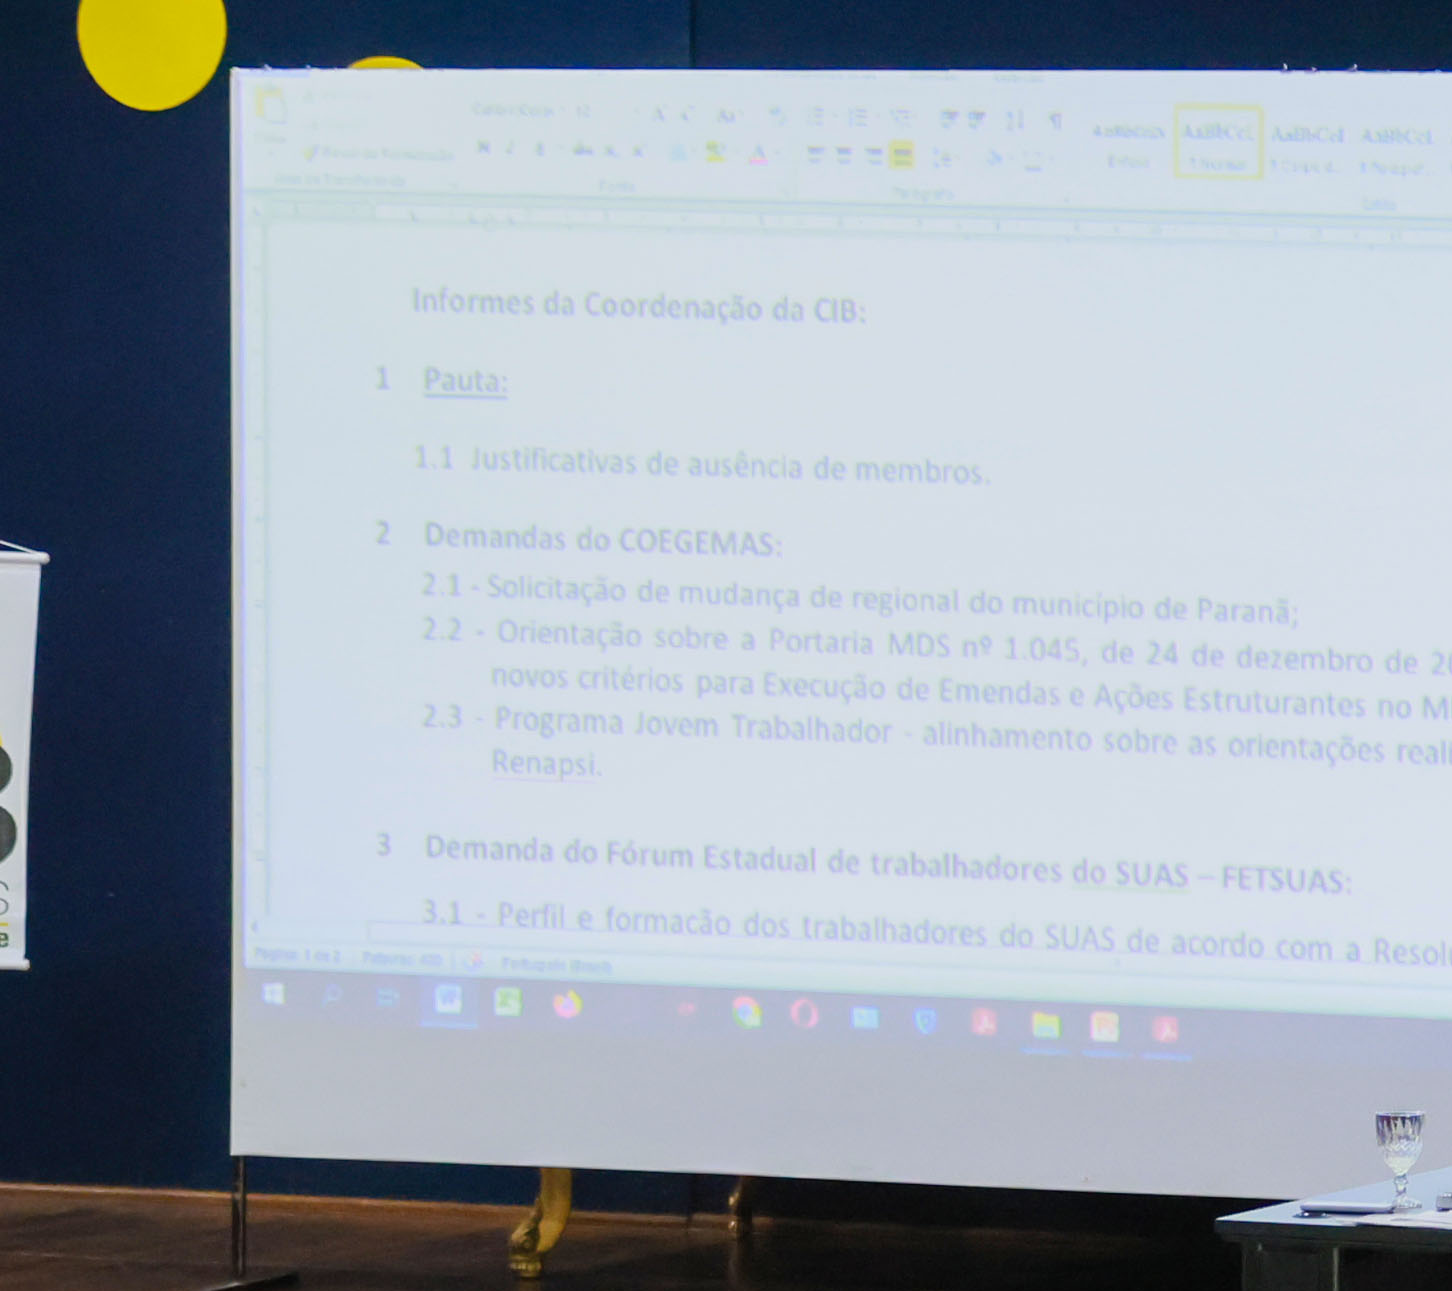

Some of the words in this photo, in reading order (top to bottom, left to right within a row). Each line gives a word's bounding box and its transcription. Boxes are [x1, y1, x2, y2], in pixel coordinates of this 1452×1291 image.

[412, 285, 536, 317] Informes
[543, 289, 576, 317] da
[584, 291, 764, 324] Coordenação
[771, 296, 806, 324] da
[813, 298, 866, 325] CIB:
[376, 365, 391, 391] 1
[424, 367, 509, 397] Pauta:
[416, 445, 454, 470] 1.1
[472, 446, 639, 477] Justificativas
[646, 450, 680, 478] de
[689, 451, 804, 481] ausência
[813, 454, 848, 483] de
[855, 458, 991, 486] membros.
[375, 519, 392, 546] 2
[424, 521, 567, 552] Demandas
[576, 526, 612, 553] do
[618, 526, 783, 559] COEGEMAS:
[422, 571, 463, 598] 2.1
[487, 573, 628, 608] Solicitação
[637, 578, 671, 605] de
[679, 581, 801, 615] mudança
[809, 584, 844, 610] de
[852, 587, 960, 619] regional
[968, 590, 1005, 616] do
[1012, 591, 1145, 626] município
[1154, 596, 1189, 623] de
[1198, 596, 1299, 631] Paranã;
[422, 615, 463, 643] 2.2
[498, 618, 643, 654] Orientação
[655, 625, 730, 651] sobre
[741, 631, 757, 652] a
[770, 626, 874, 656] Portaria
[889, 631, 952, 659] MDS
[1101, 639, 1135, 666] de
[1147, 639, 1179, 667] 24
[1191, 642, 1226, 669] de
[1236, 644, 1375, 675] dezembro
[1384, 649, 1419, 676] de
[492, 667, 569, 690] novos
[578, 665, 684, 694] critérios
[697, 674, 755, 700] para
[763, 671, 887, 706] Execução
[897, 676, 931, 703] de
[939, 676, 1061, 708] Emendas
[1069, 687, 1085, 709] e
[1093, 682, 1174, 716] Ações
[1184, 685, 1368, 719] Estruturantes
[1378, 698, 1413, 721] no
[422, 703, 464, 730] 2.3
[496, 705, 625, 740] Programa
[635, 711, 720, 738] Jovem
[731, 713, 895, 745] Trabalhador
[922, 720, 1094, 753] alinhamento
[1103, 727, 1179, 756] sobre
[1187, 735, 1219, 758] as
[1228, 733, 1387, 770] orientações
[492, 750, 603, 781] Renapsi.
[376, 831, 392, 858] 3
[426, 833, 556, 864] Demanda
[563, 837, 599, 866] do
[607, 839, 696, 870] Fórum
[703, 843, 818, 875] Estadual
[827, 847, 862, 877] de
[870, 850, 1065, 885] trabalhadores
[1071, 857, 1108, 887] do
[1115, 859, 1190, 891] SUAS
[1222, 867, 1353, 896] FETSUAS:
[422, 898, 464, 922] 3.1
[498, 901, 566, 930] Perfil
[577, 910, 595, 932] e
[743, 911, 791, 935] dos
[802, 915, 988, 943] trabalhadores
[999, 922, 1040, 950] do
[1045, 923, 1117, 953] SUAS
[1126, 927, 1161, 950] de
[1172, 931, 1266, 960] acordo
[1275, 938, 1334, 958] com
[1345, 941, 1365, 963] a
